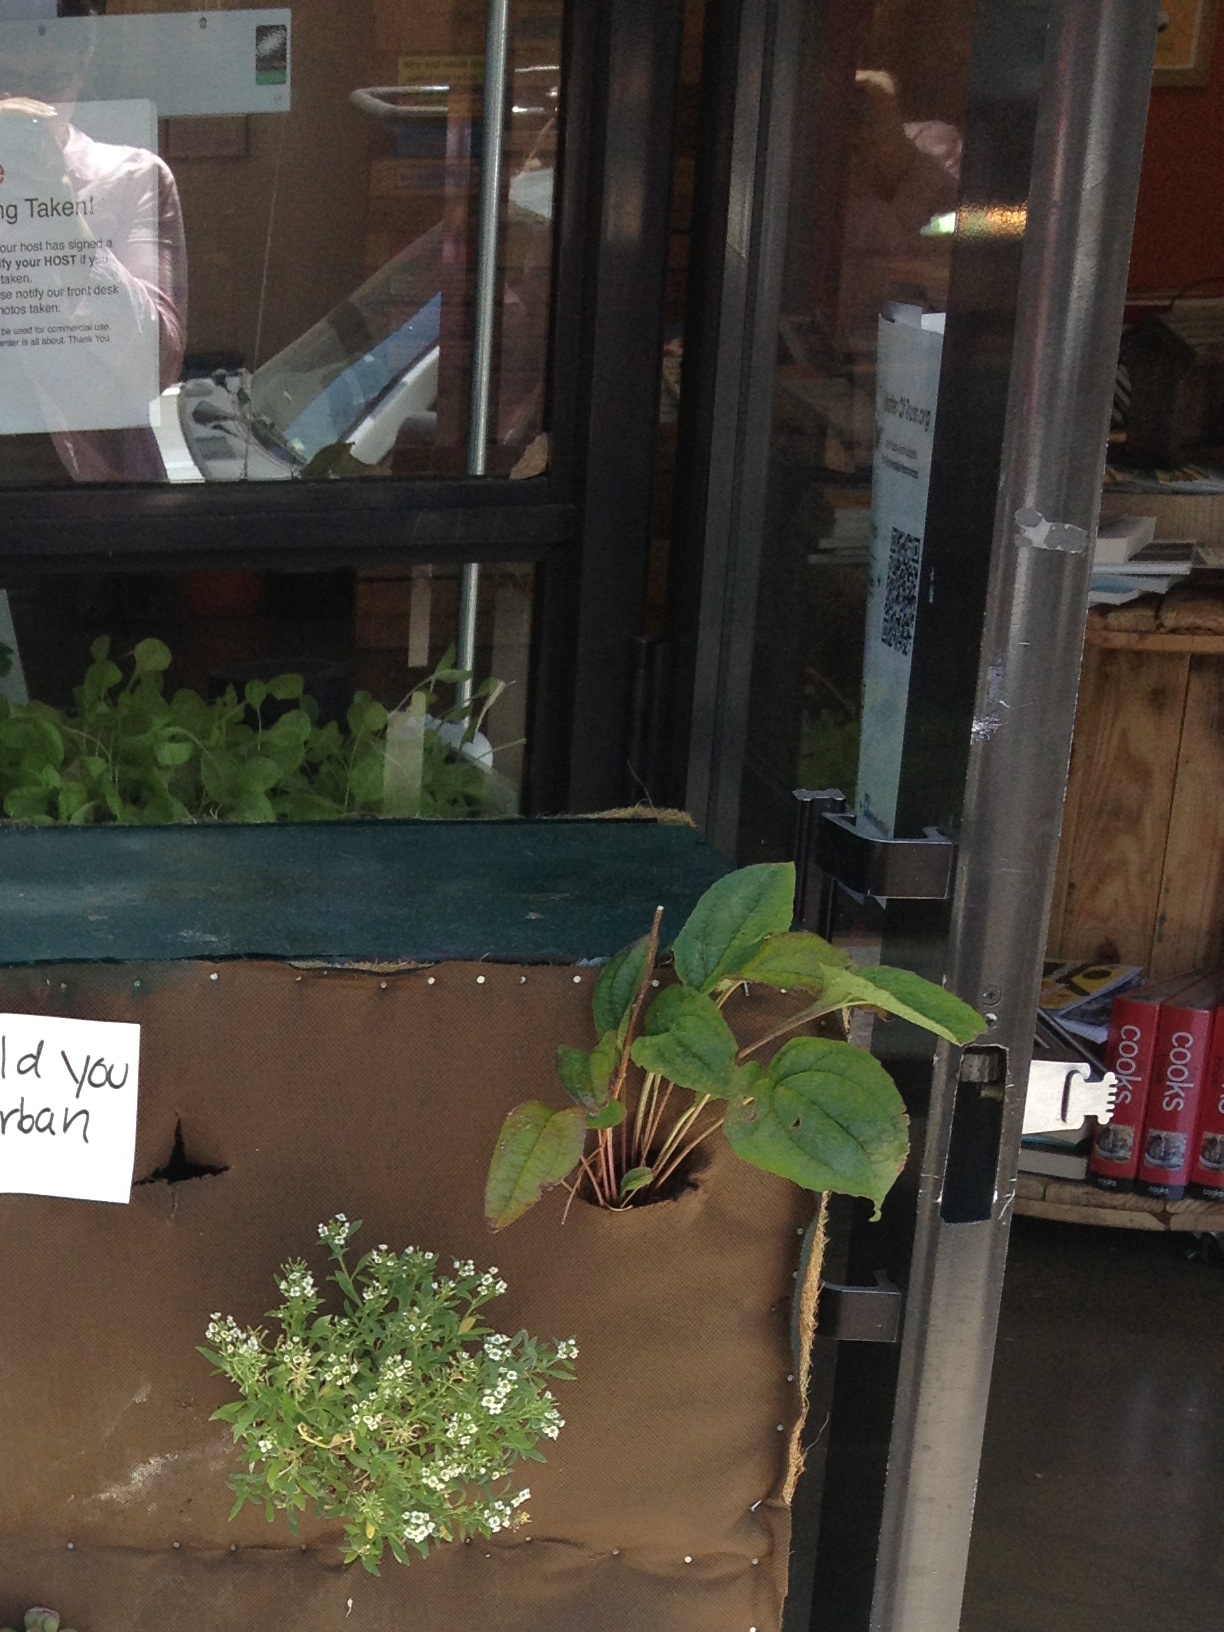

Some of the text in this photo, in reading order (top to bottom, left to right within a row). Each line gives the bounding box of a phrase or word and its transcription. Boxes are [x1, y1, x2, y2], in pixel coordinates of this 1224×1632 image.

[24, 197, 95, 218] Taken!
[20, 241, 43, 252] host
[45, 240, 65, 251] has
[68, 238, 103, 253] signed
[15, 256, 41, 270] your
[44, 254, 77, 267] HOST
[79, 254, 87, 265] if
[1, 273, 33, 285] taken.
[15, 287, 44, 301] notify
[47, 287, 65, 298] our
[67, 285, 91, 297] front
[93, 284, 120, 296] desk
[29, 302, 61, 314] taken.
[1162, 1031, 1194, 1112] cooks
